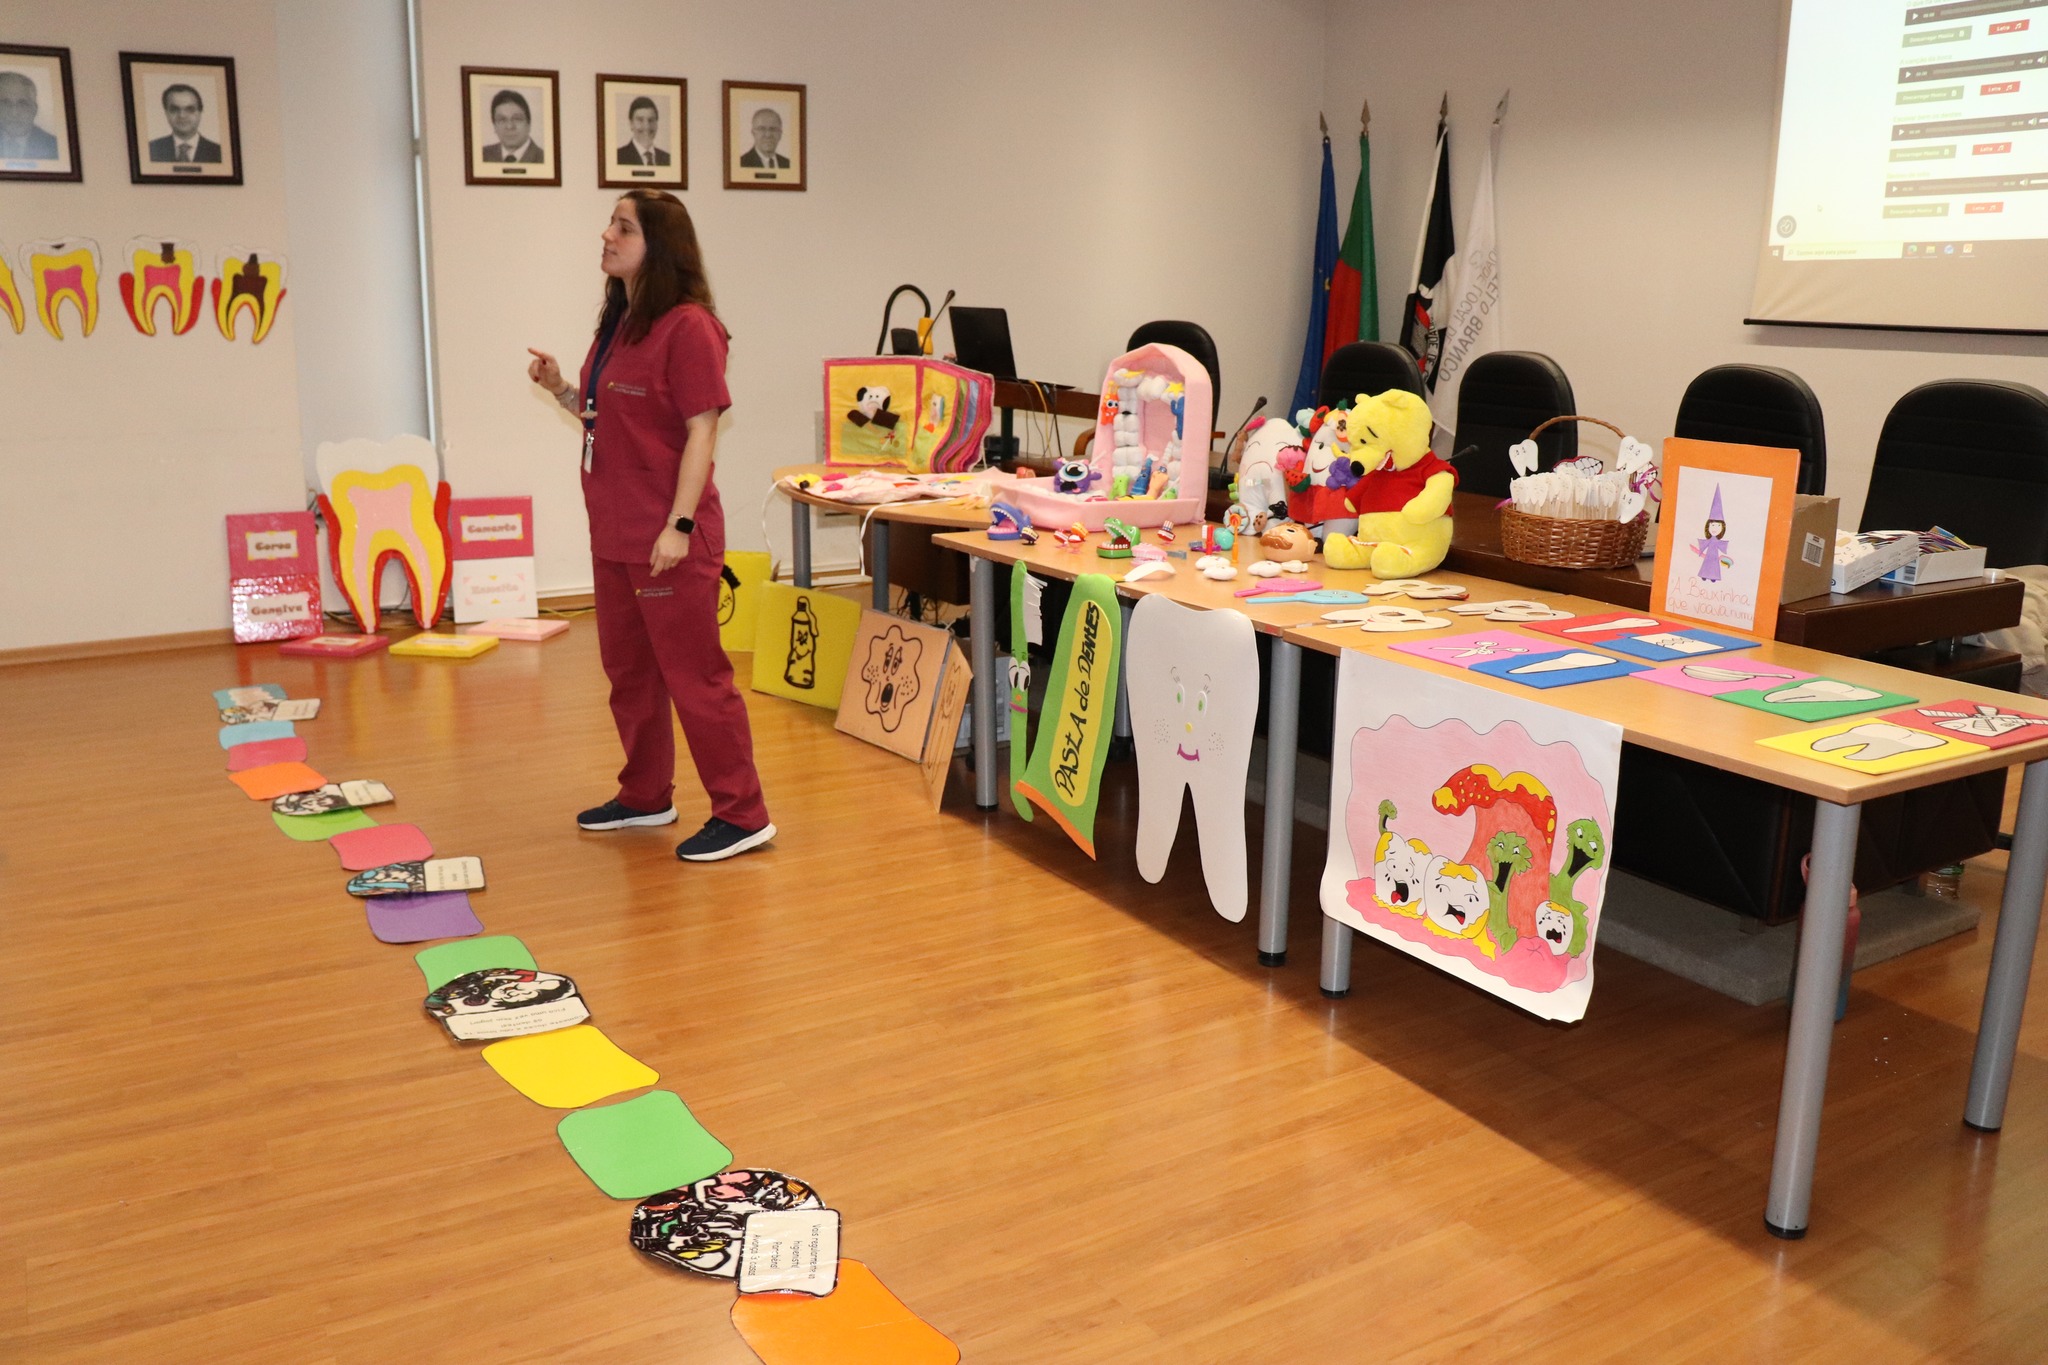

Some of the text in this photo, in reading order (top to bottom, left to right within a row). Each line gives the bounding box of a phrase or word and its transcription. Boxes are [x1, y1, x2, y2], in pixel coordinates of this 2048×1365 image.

[1668, 596, 1688, 613] que
[1694, 602, 1729, 617] voava
[1074, 680, 1091, 712] de
